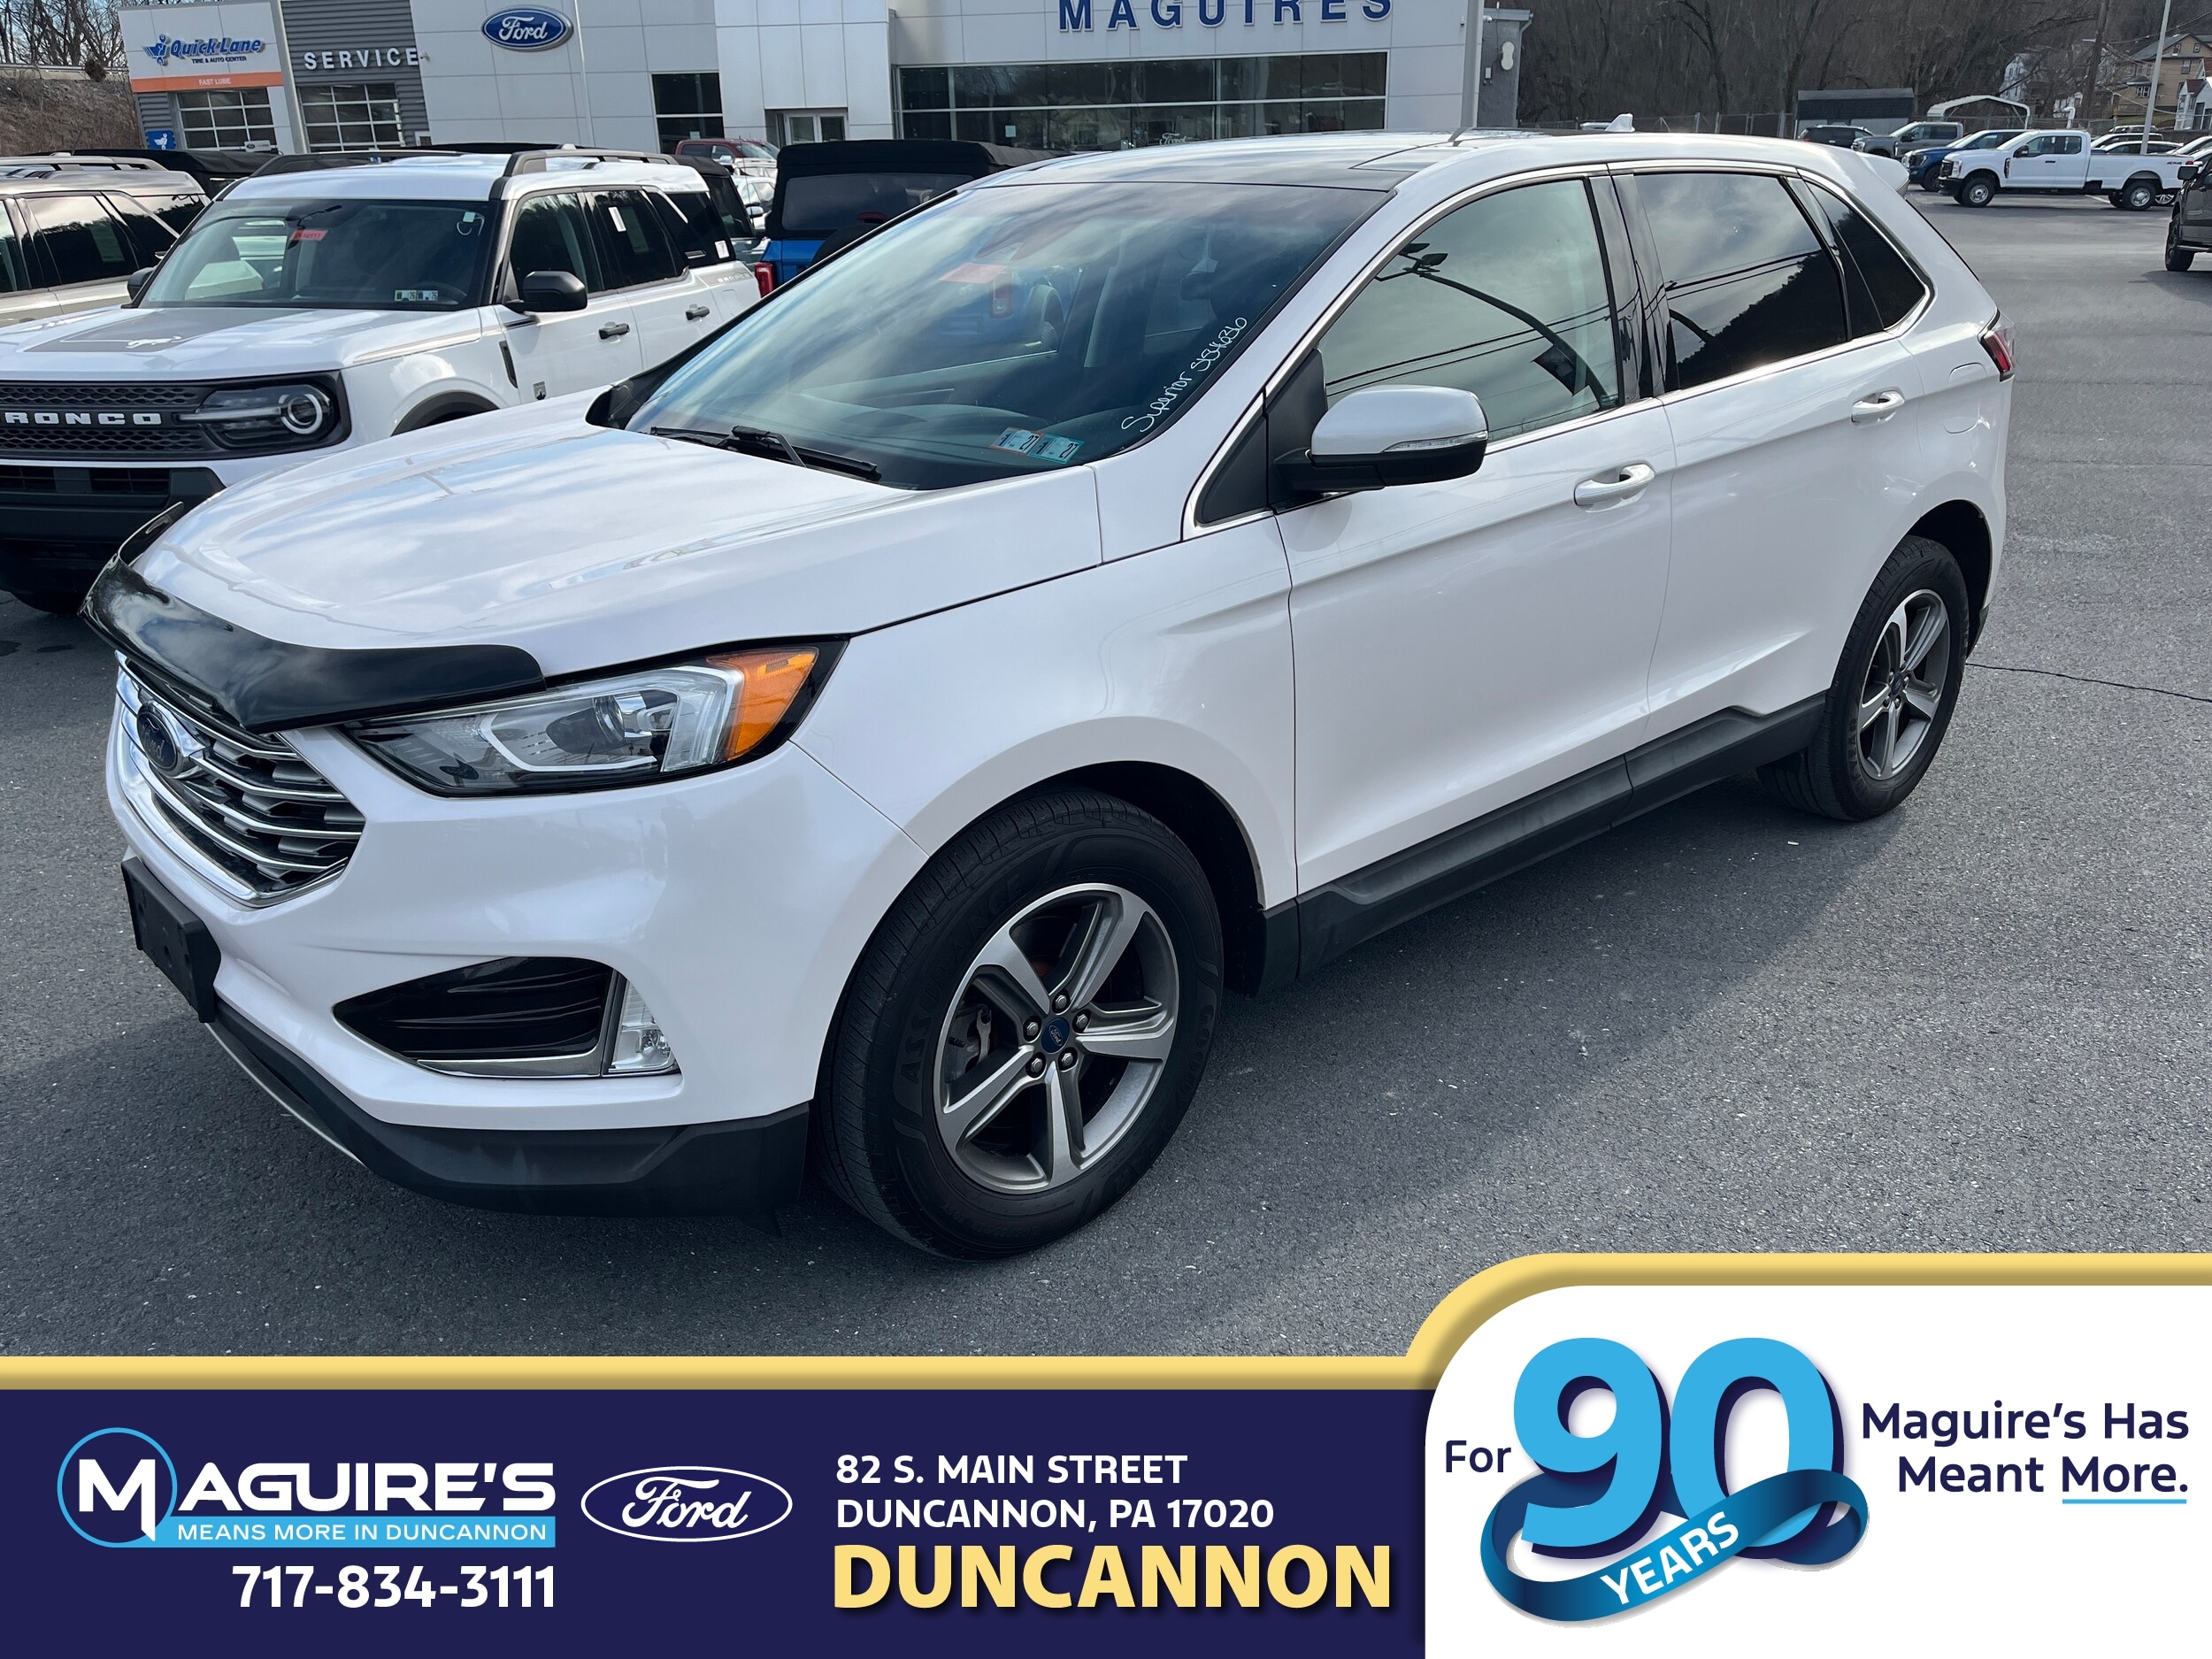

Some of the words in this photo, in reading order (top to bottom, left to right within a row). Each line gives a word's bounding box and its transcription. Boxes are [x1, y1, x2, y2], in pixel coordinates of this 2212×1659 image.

[498, 16, 548, 42] Ford
[171, 39, 218, 58] Quick
[219, 37, 263, 53] Lane
[303, 48, 419, 71] SERVICE
[1160, 133, 1187, 145] Ford
[1121, 371, 1193, 433] Superior
[1018, 435, 1040, 451] 27
[1058, 442, 1079, 459] 27
